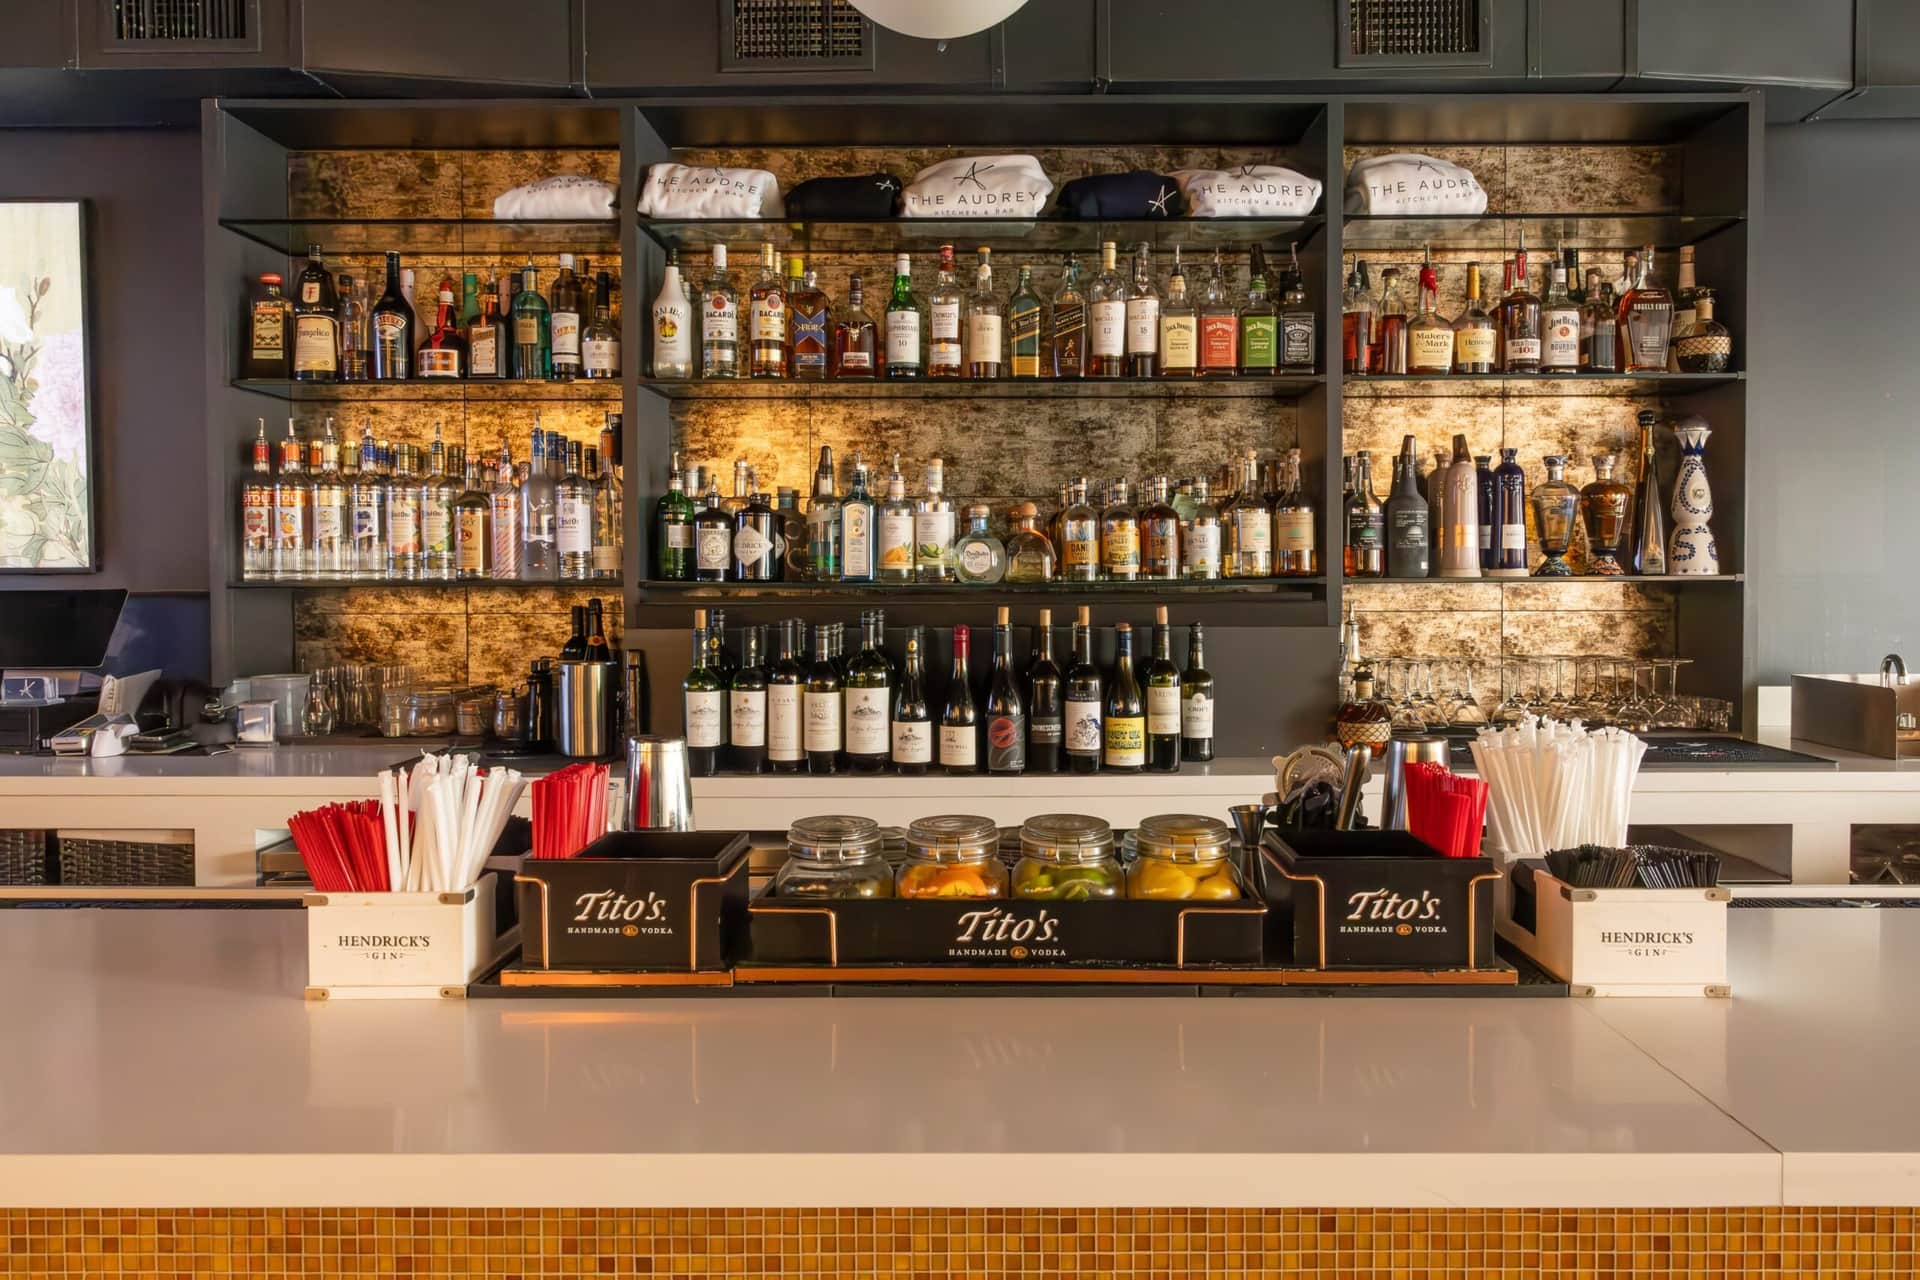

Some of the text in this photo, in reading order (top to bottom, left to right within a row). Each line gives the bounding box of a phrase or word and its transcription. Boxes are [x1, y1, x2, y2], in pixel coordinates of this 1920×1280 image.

[689, 177, 758, 194] AUDRE
[1201, 183, 1317, 197] HE AUDREY
[1370, 181, 1407, 197] THE
[911, 191, 1039, 206] THE AUDREY
[338, 935, 431, 948] HENDRICK'S
[1600, 931, 1694, 944] HENDRICK'S
[371, 952, 398, 960] GIN
[1634, 948, 1661, 956] GIN
